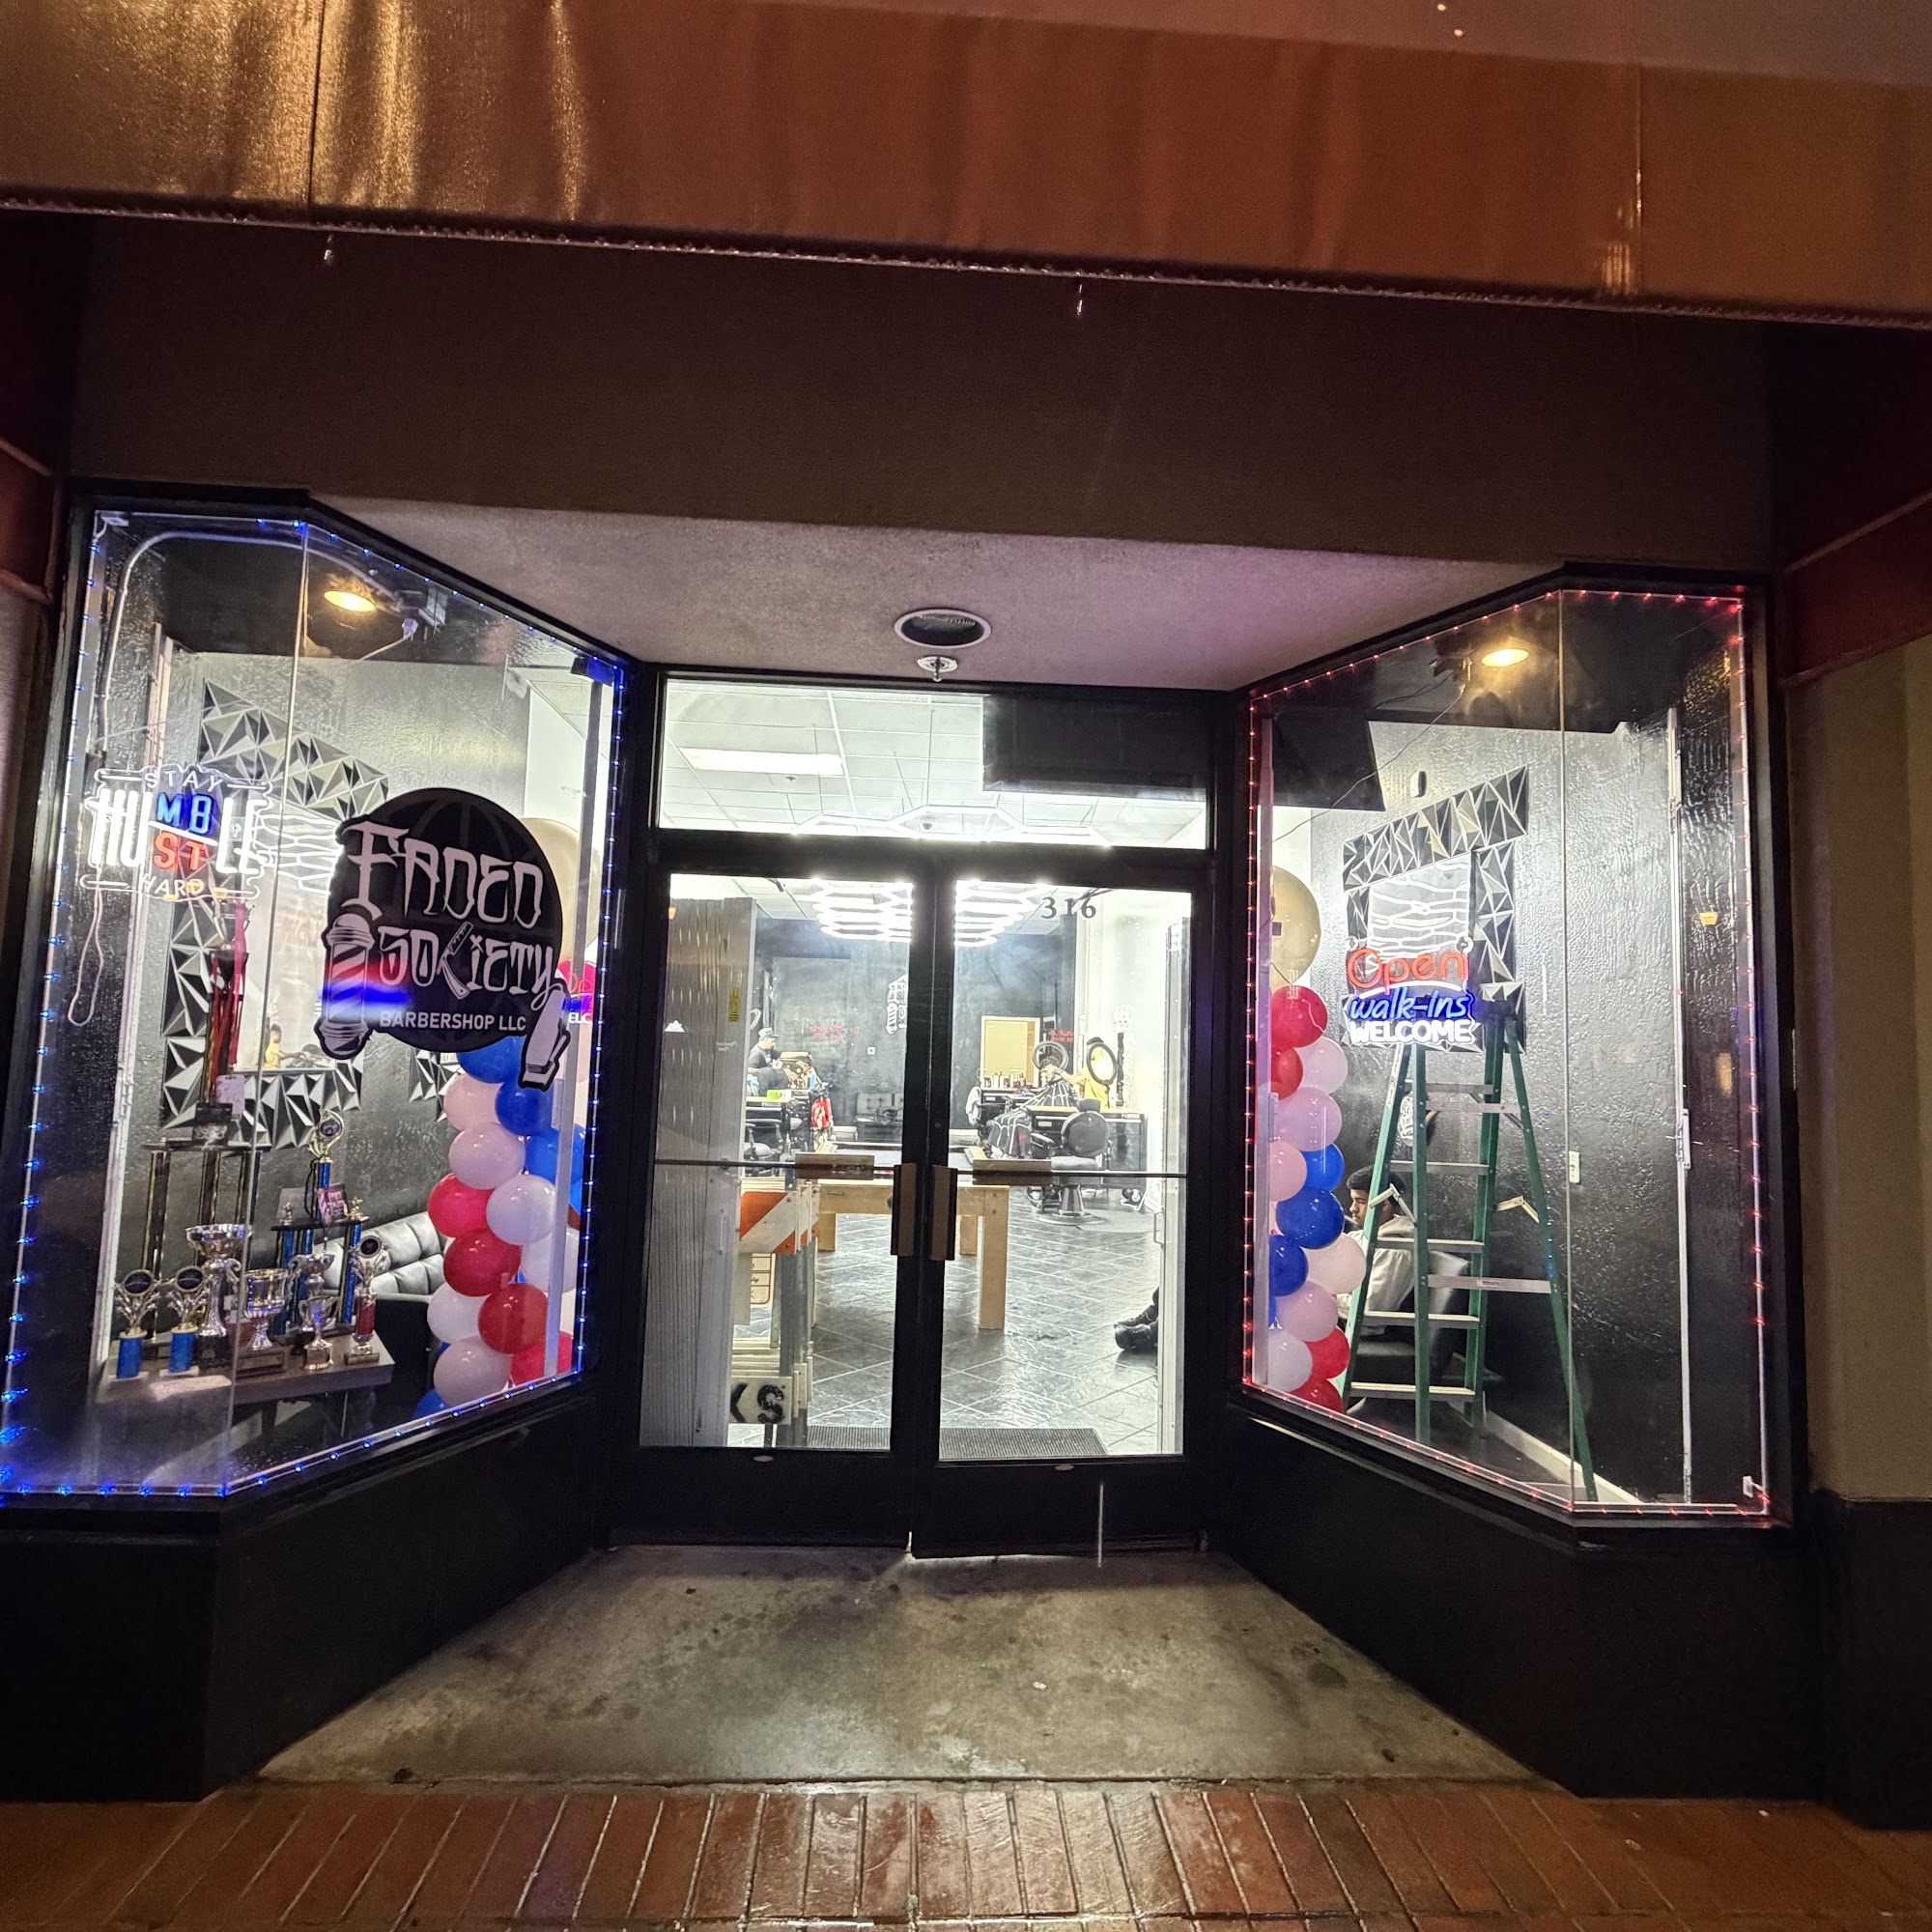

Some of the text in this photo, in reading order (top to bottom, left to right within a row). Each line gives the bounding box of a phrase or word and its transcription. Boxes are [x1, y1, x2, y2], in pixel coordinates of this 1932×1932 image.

[145, 769, 223, 792] STAY
[141, 873, 205, 896] HARD
[341, 821, 544, 929] FADED
[1040, 895, 1097, 920] 316
[1347, 948, 1468, 996] Open
[379, 1010, 527, 1032] BARBERSHOP LLC
[1350, 1020, 1471, 1043] WELCOME
